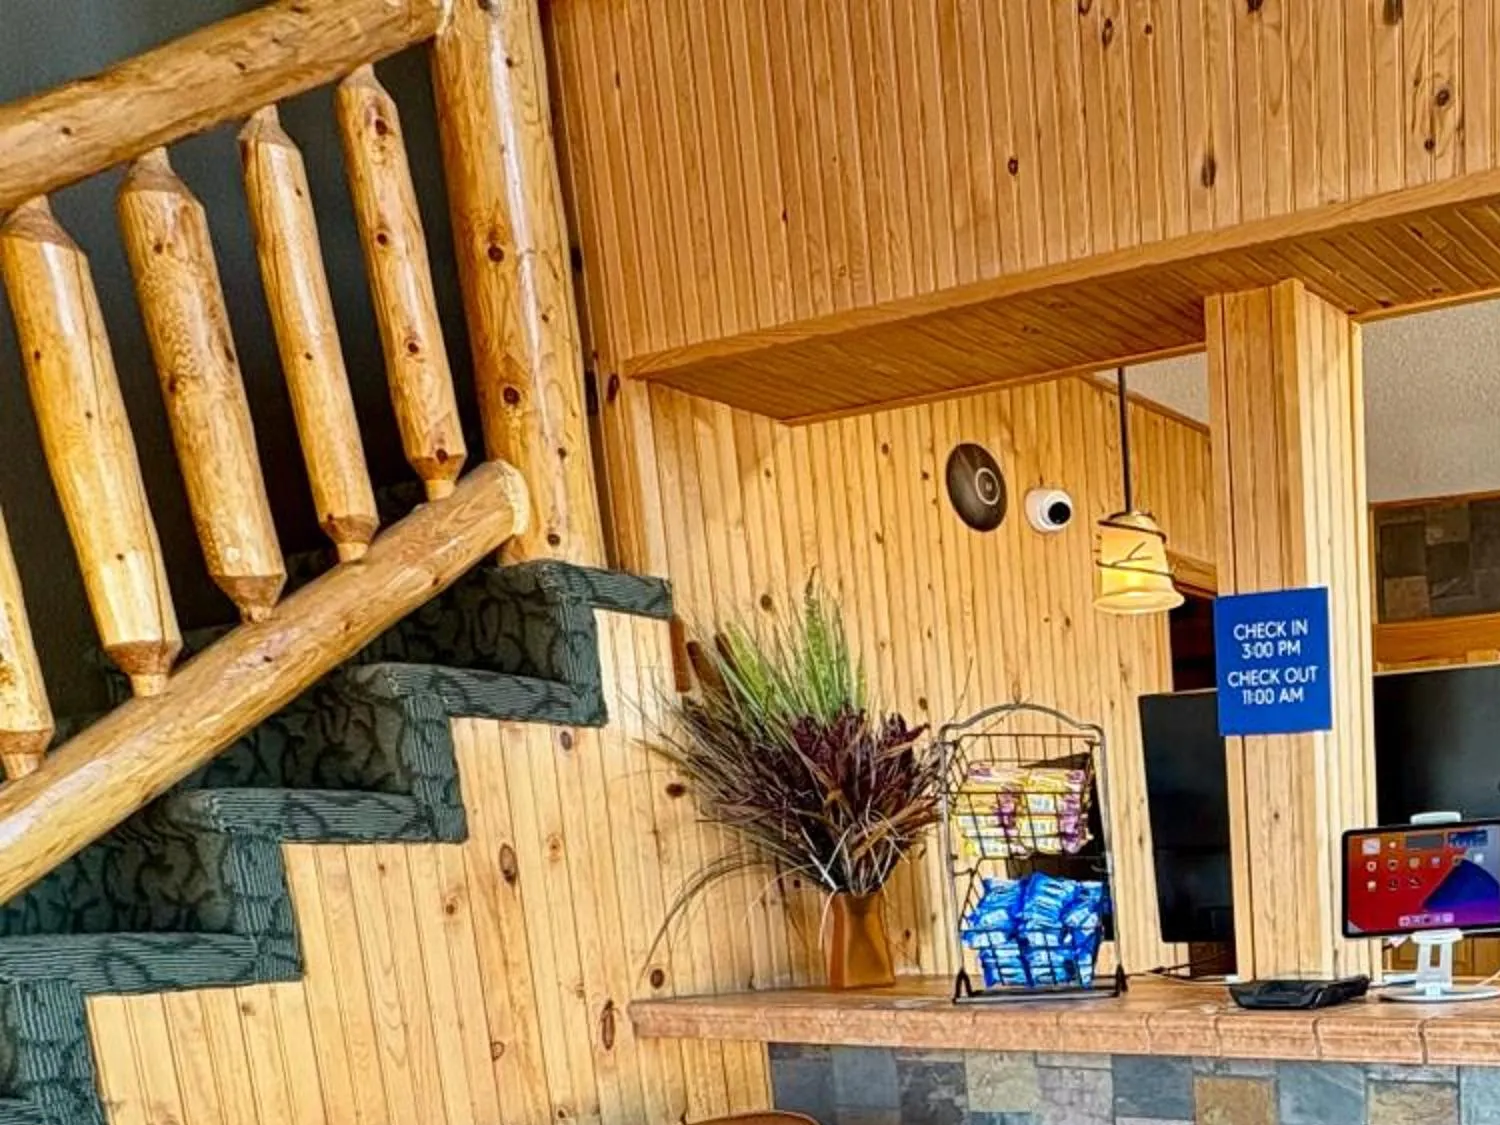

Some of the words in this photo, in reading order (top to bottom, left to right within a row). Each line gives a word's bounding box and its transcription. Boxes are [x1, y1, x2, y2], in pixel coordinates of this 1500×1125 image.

[1233, 621, 1287, 641] CHECK
[1291, 619, 1308, 637] IN
[1241, 642, 1273, 660] 3:00
[1277, 639, 1301, 657] PM
[1227, 668, 1280, 688] CHECK
[1284, 665, 1319, 684] OUT
[1242, 688, 1275, 705] 11:00
[1278, 687, 1304, 704] AM
